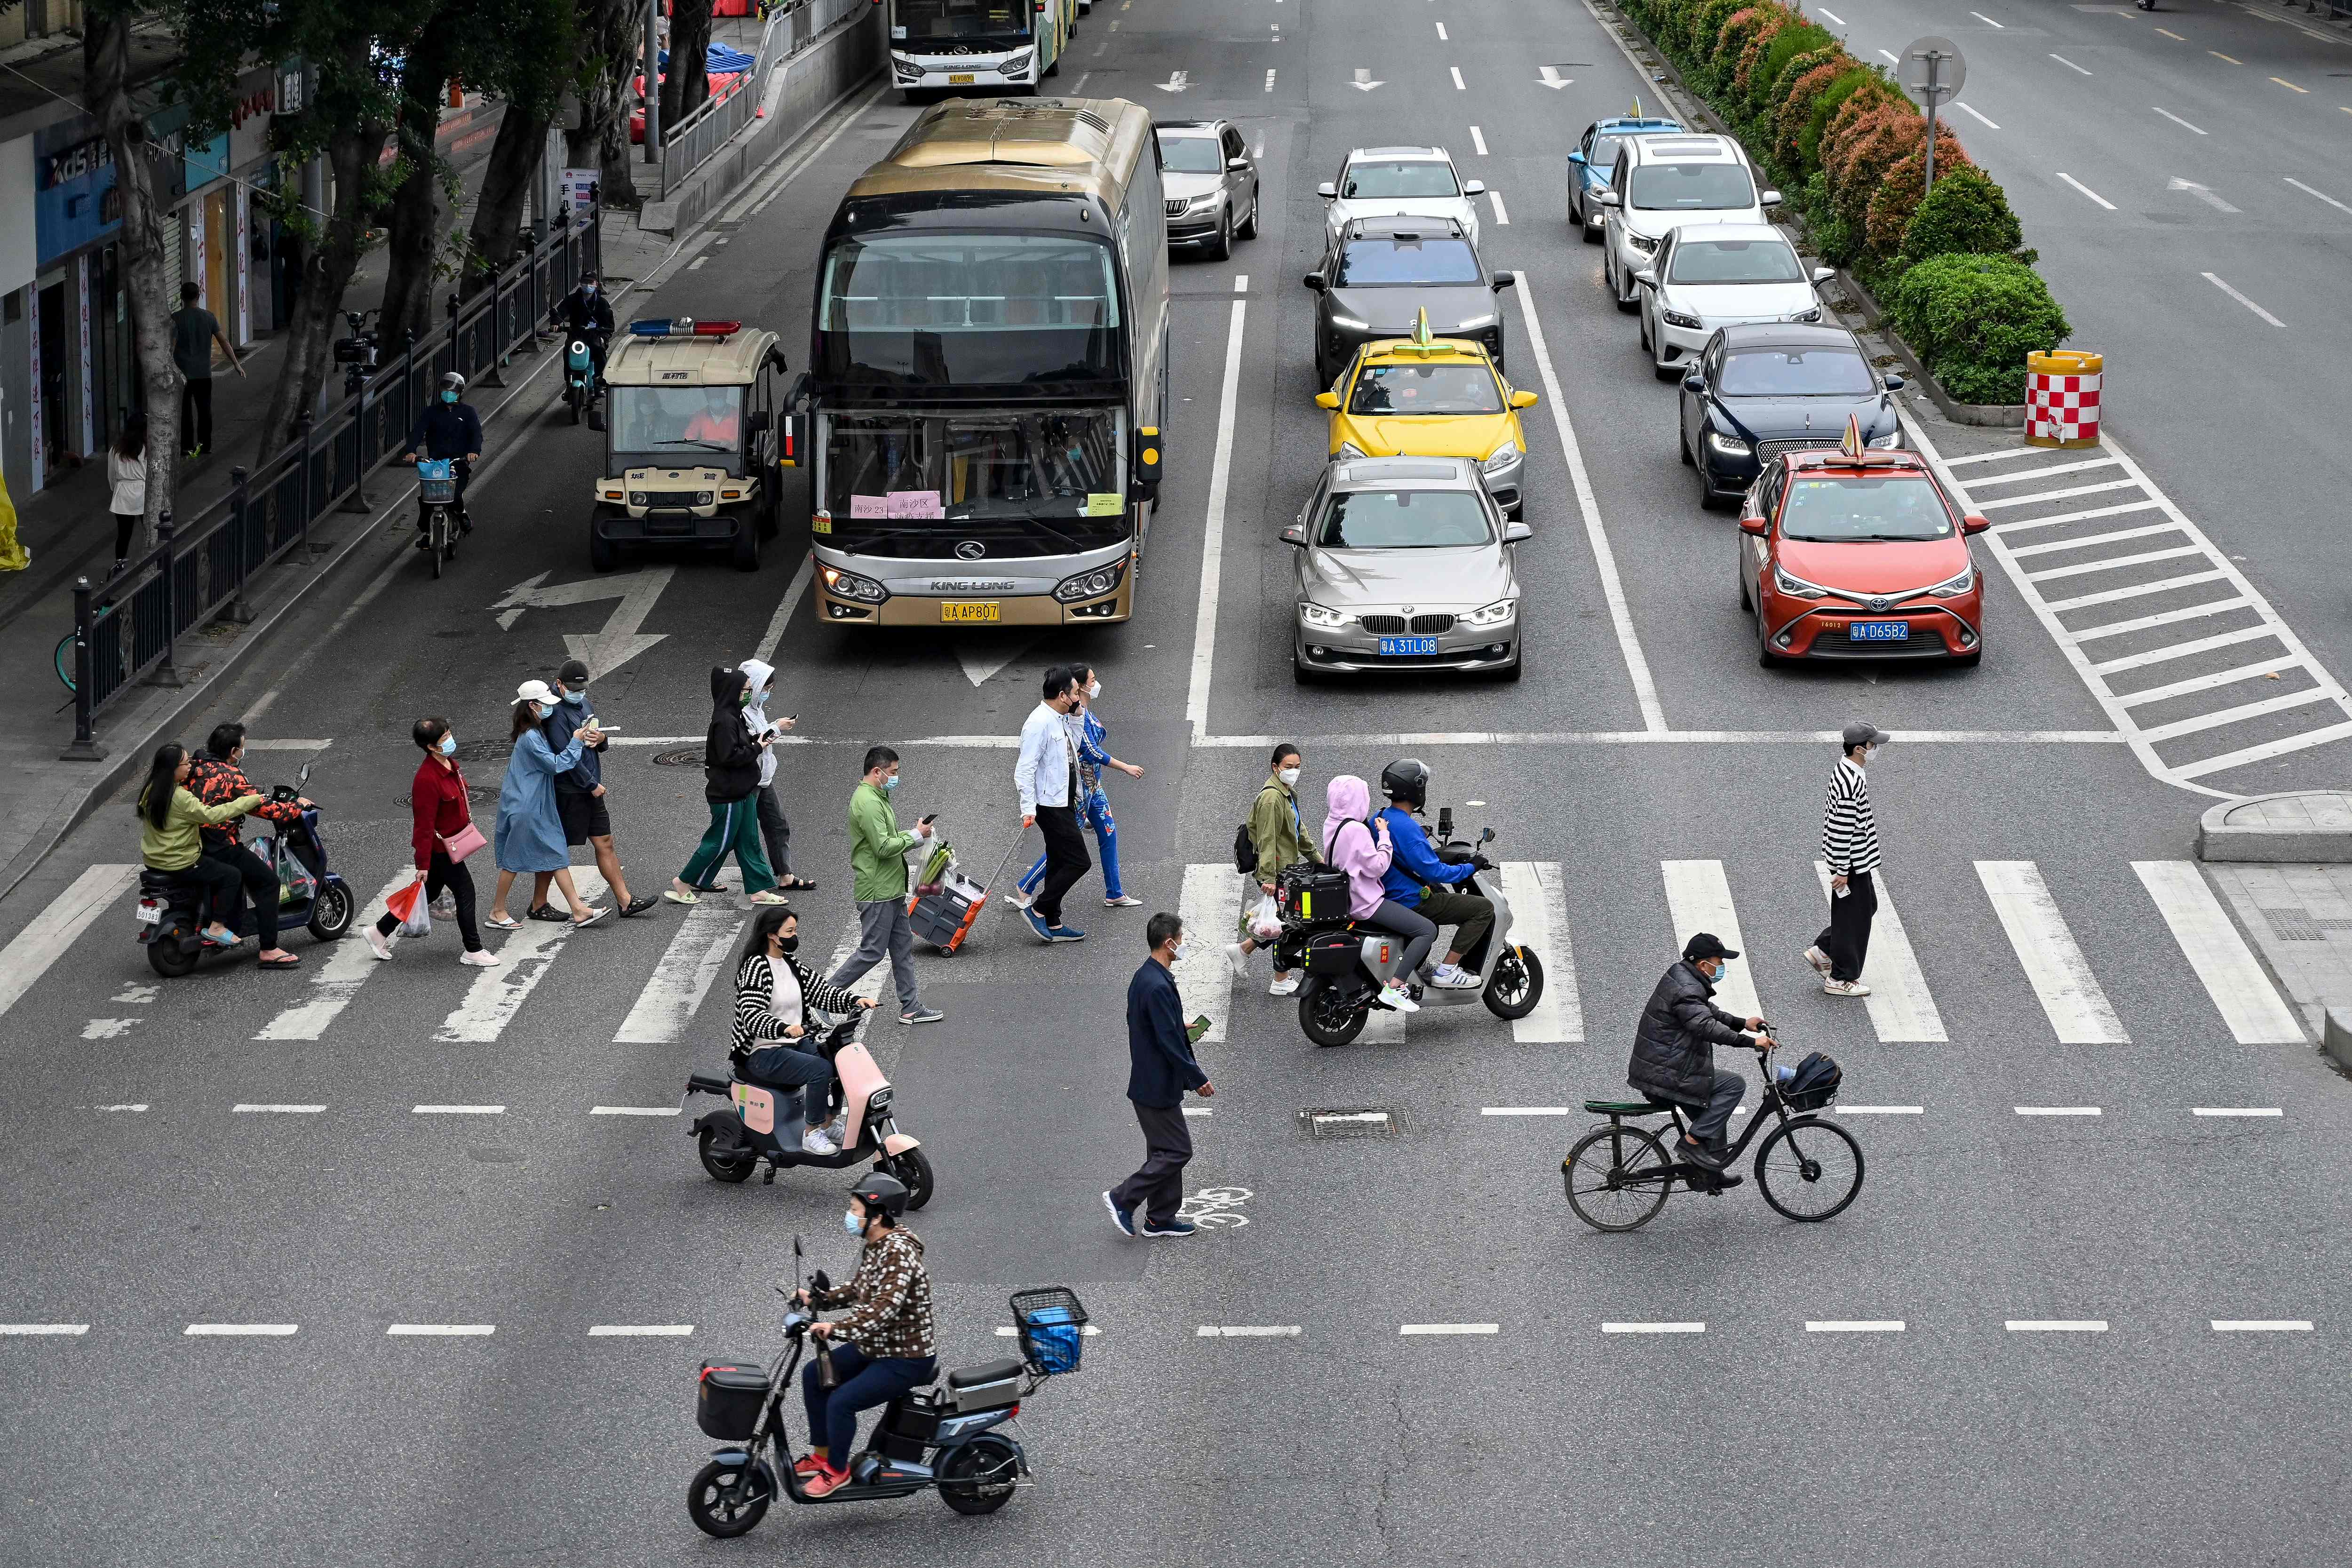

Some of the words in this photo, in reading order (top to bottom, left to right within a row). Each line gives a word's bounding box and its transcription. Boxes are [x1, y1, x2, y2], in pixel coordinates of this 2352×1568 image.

[854, 504, 872, 514] 南沙
[899, 499, 929, 509] 南沙区
[930, 581, 968, 590] KING
[971, 581, 1015, 590] LONG
